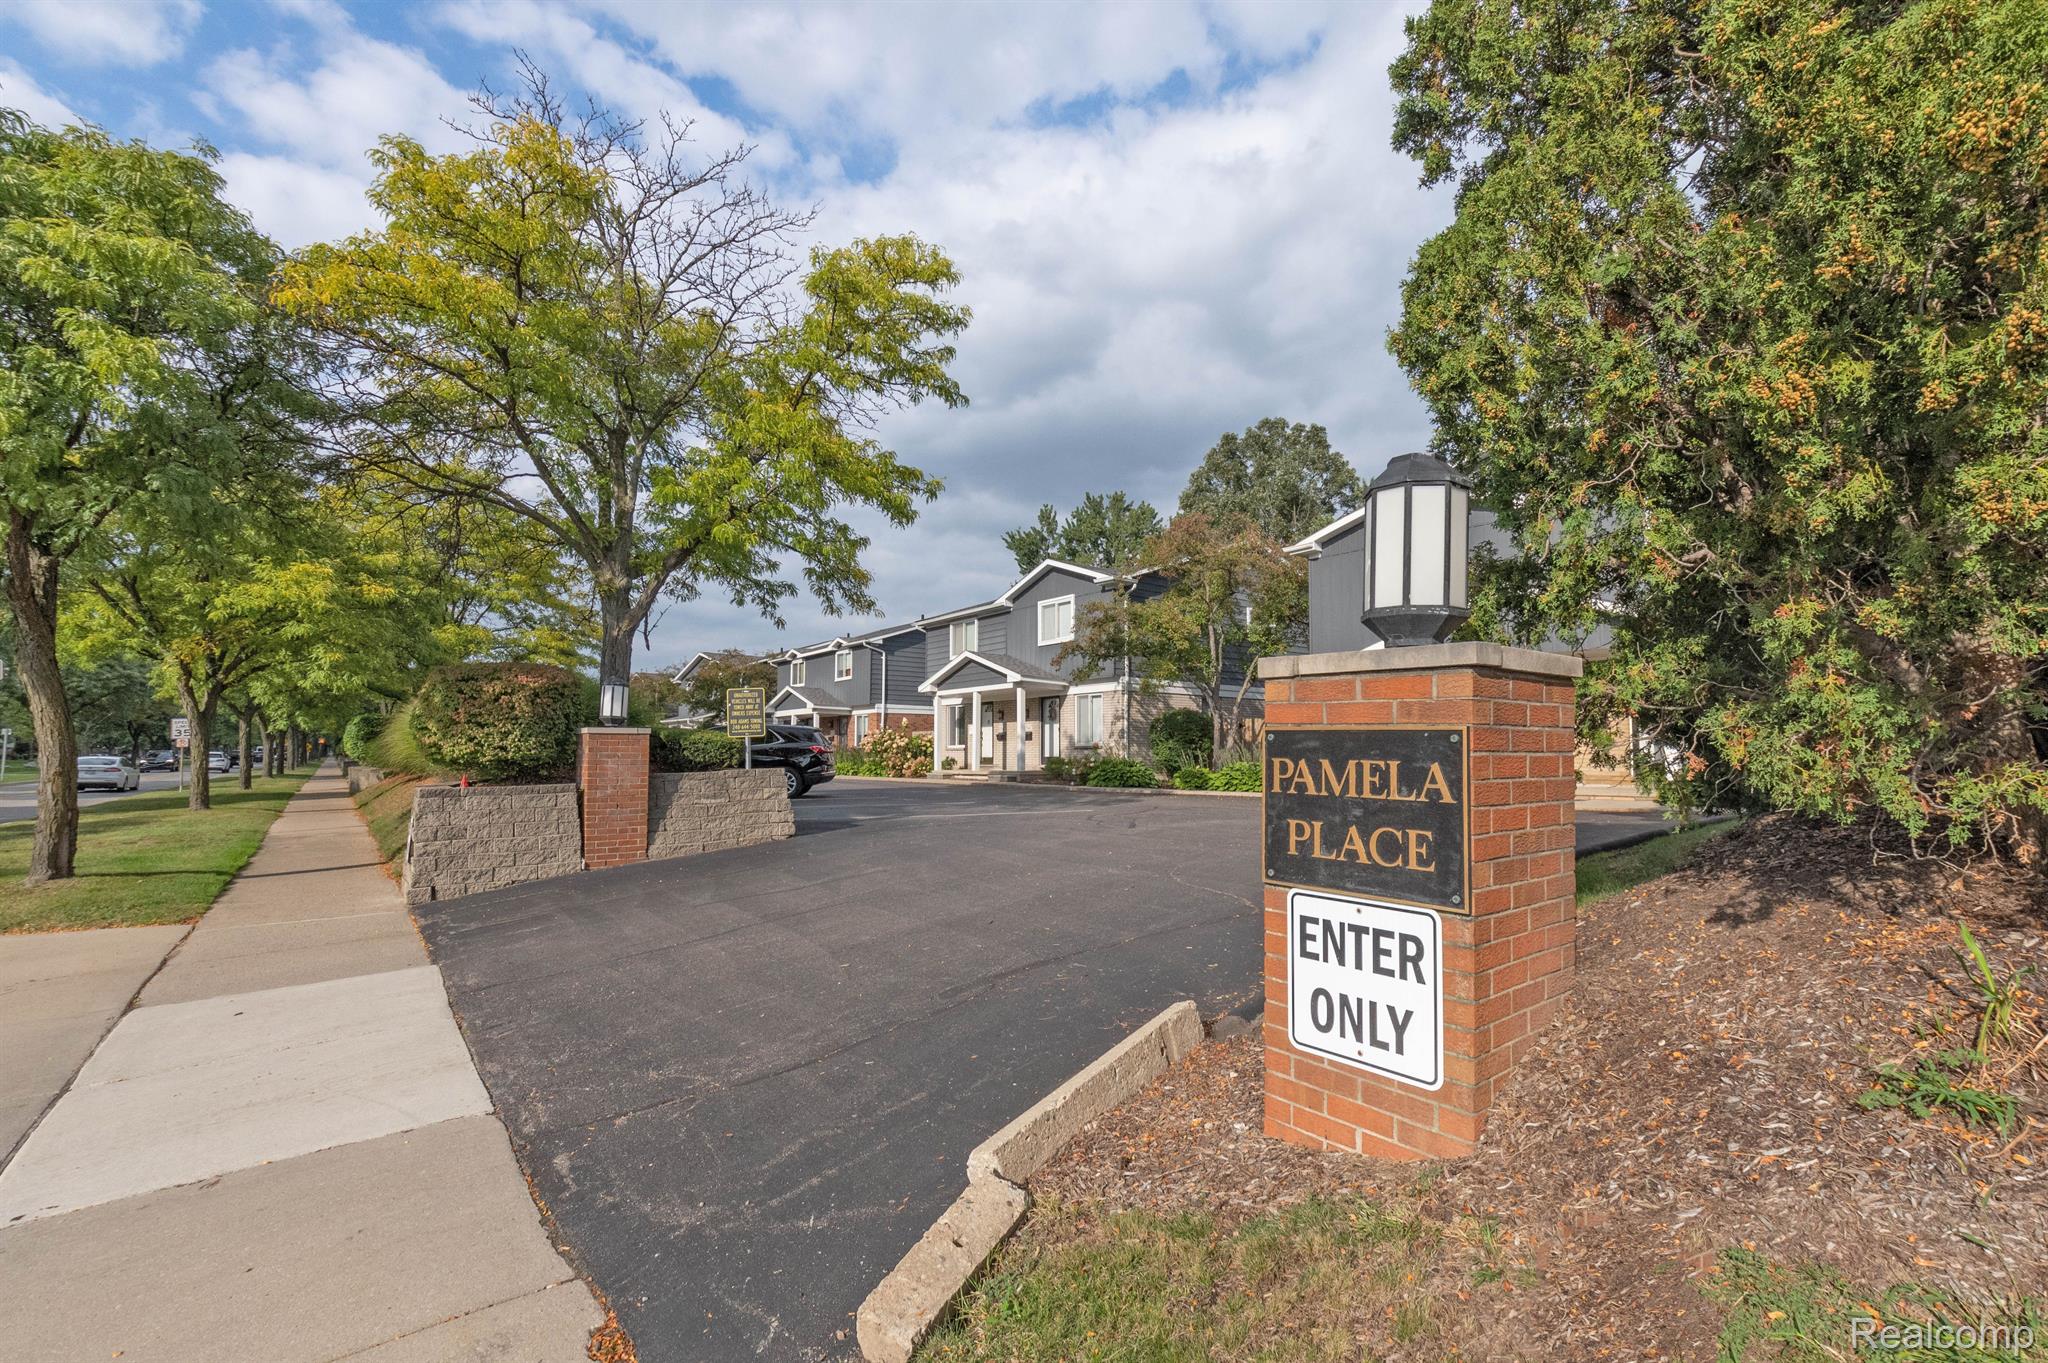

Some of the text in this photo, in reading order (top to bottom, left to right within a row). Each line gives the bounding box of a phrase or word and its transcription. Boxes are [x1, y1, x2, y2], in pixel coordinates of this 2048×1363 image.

[174, 729, 191, 737] 35
[1270, 757, 1457, 804] PAMELA
[1286, 819, 1436, 873] PLACE
[1299, 914, 1426, 985] ENTER
[1310, 987, 1414, 1056] ONLY
